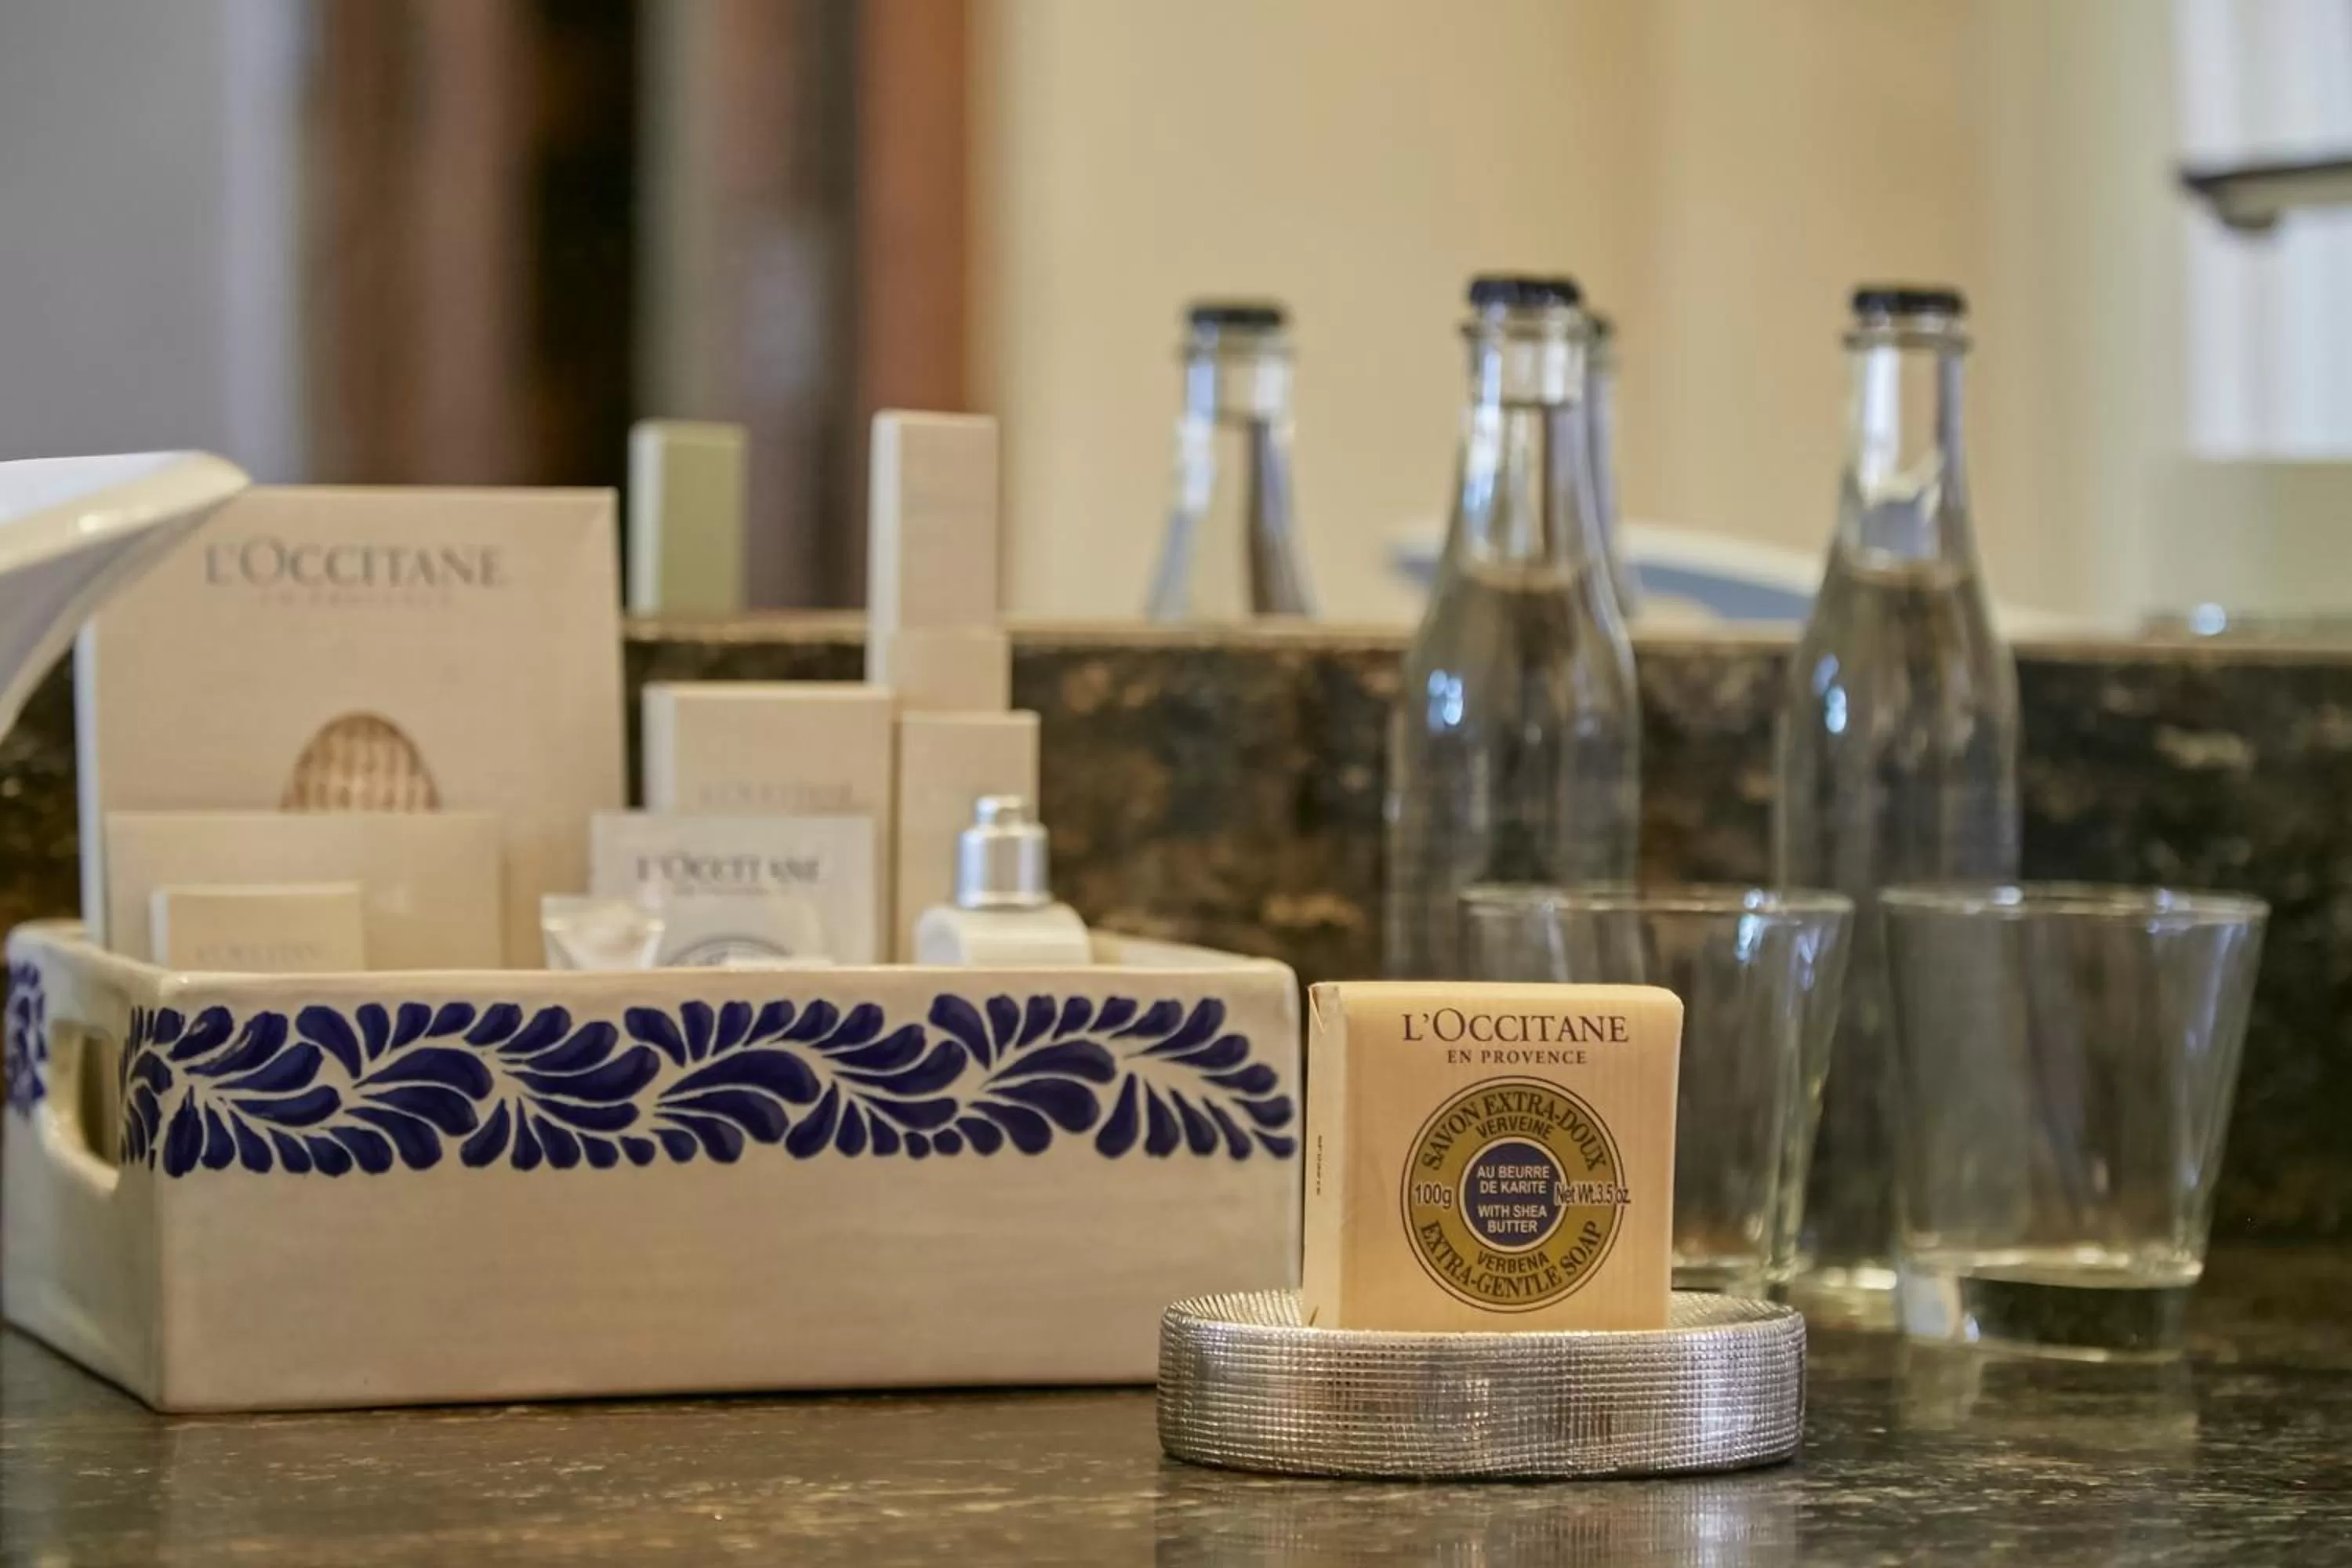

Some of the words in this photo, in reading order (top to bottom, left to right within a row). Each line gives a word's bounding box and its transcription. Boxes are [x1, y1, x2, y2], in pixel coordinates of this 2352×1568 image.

[205, 532, 514, 588] L'OCCITANE
[1402, 1007, 1629, 1042] L'OCCITANE
[1447, 1050, 1472, 1064] EN
[1481, 1050, 1587, 1065] PROVENCE
[1421, 1101, 1480, 1171] SAVON
[1484, 1091, 1607, 1172] EXTRA-DOUX
[1475, 1115, 1555, 1141] VERVEINE
[1477, 1166, 1495, 1178] AU
[1498, 1165, 1550, 1178] BEURRE
[1414, 1183, 1453, 1210] 100g
[1480, 1180, 1497, 1194] DE
[1501, 1180, 1547, 1194] KARITE
[1477, 1204, 1510, 1218] WITH
[1513, 1204, 1548, 1218] SHEA
[1487, 1219, 1538, 1233] BUTTER
[1420, 1219, 1563, 1298] EXTRA-GENTLE
[1559, 1220, 1603, 1276] SOAP
[1477, 1251, 1550, 1275] VERBENA
